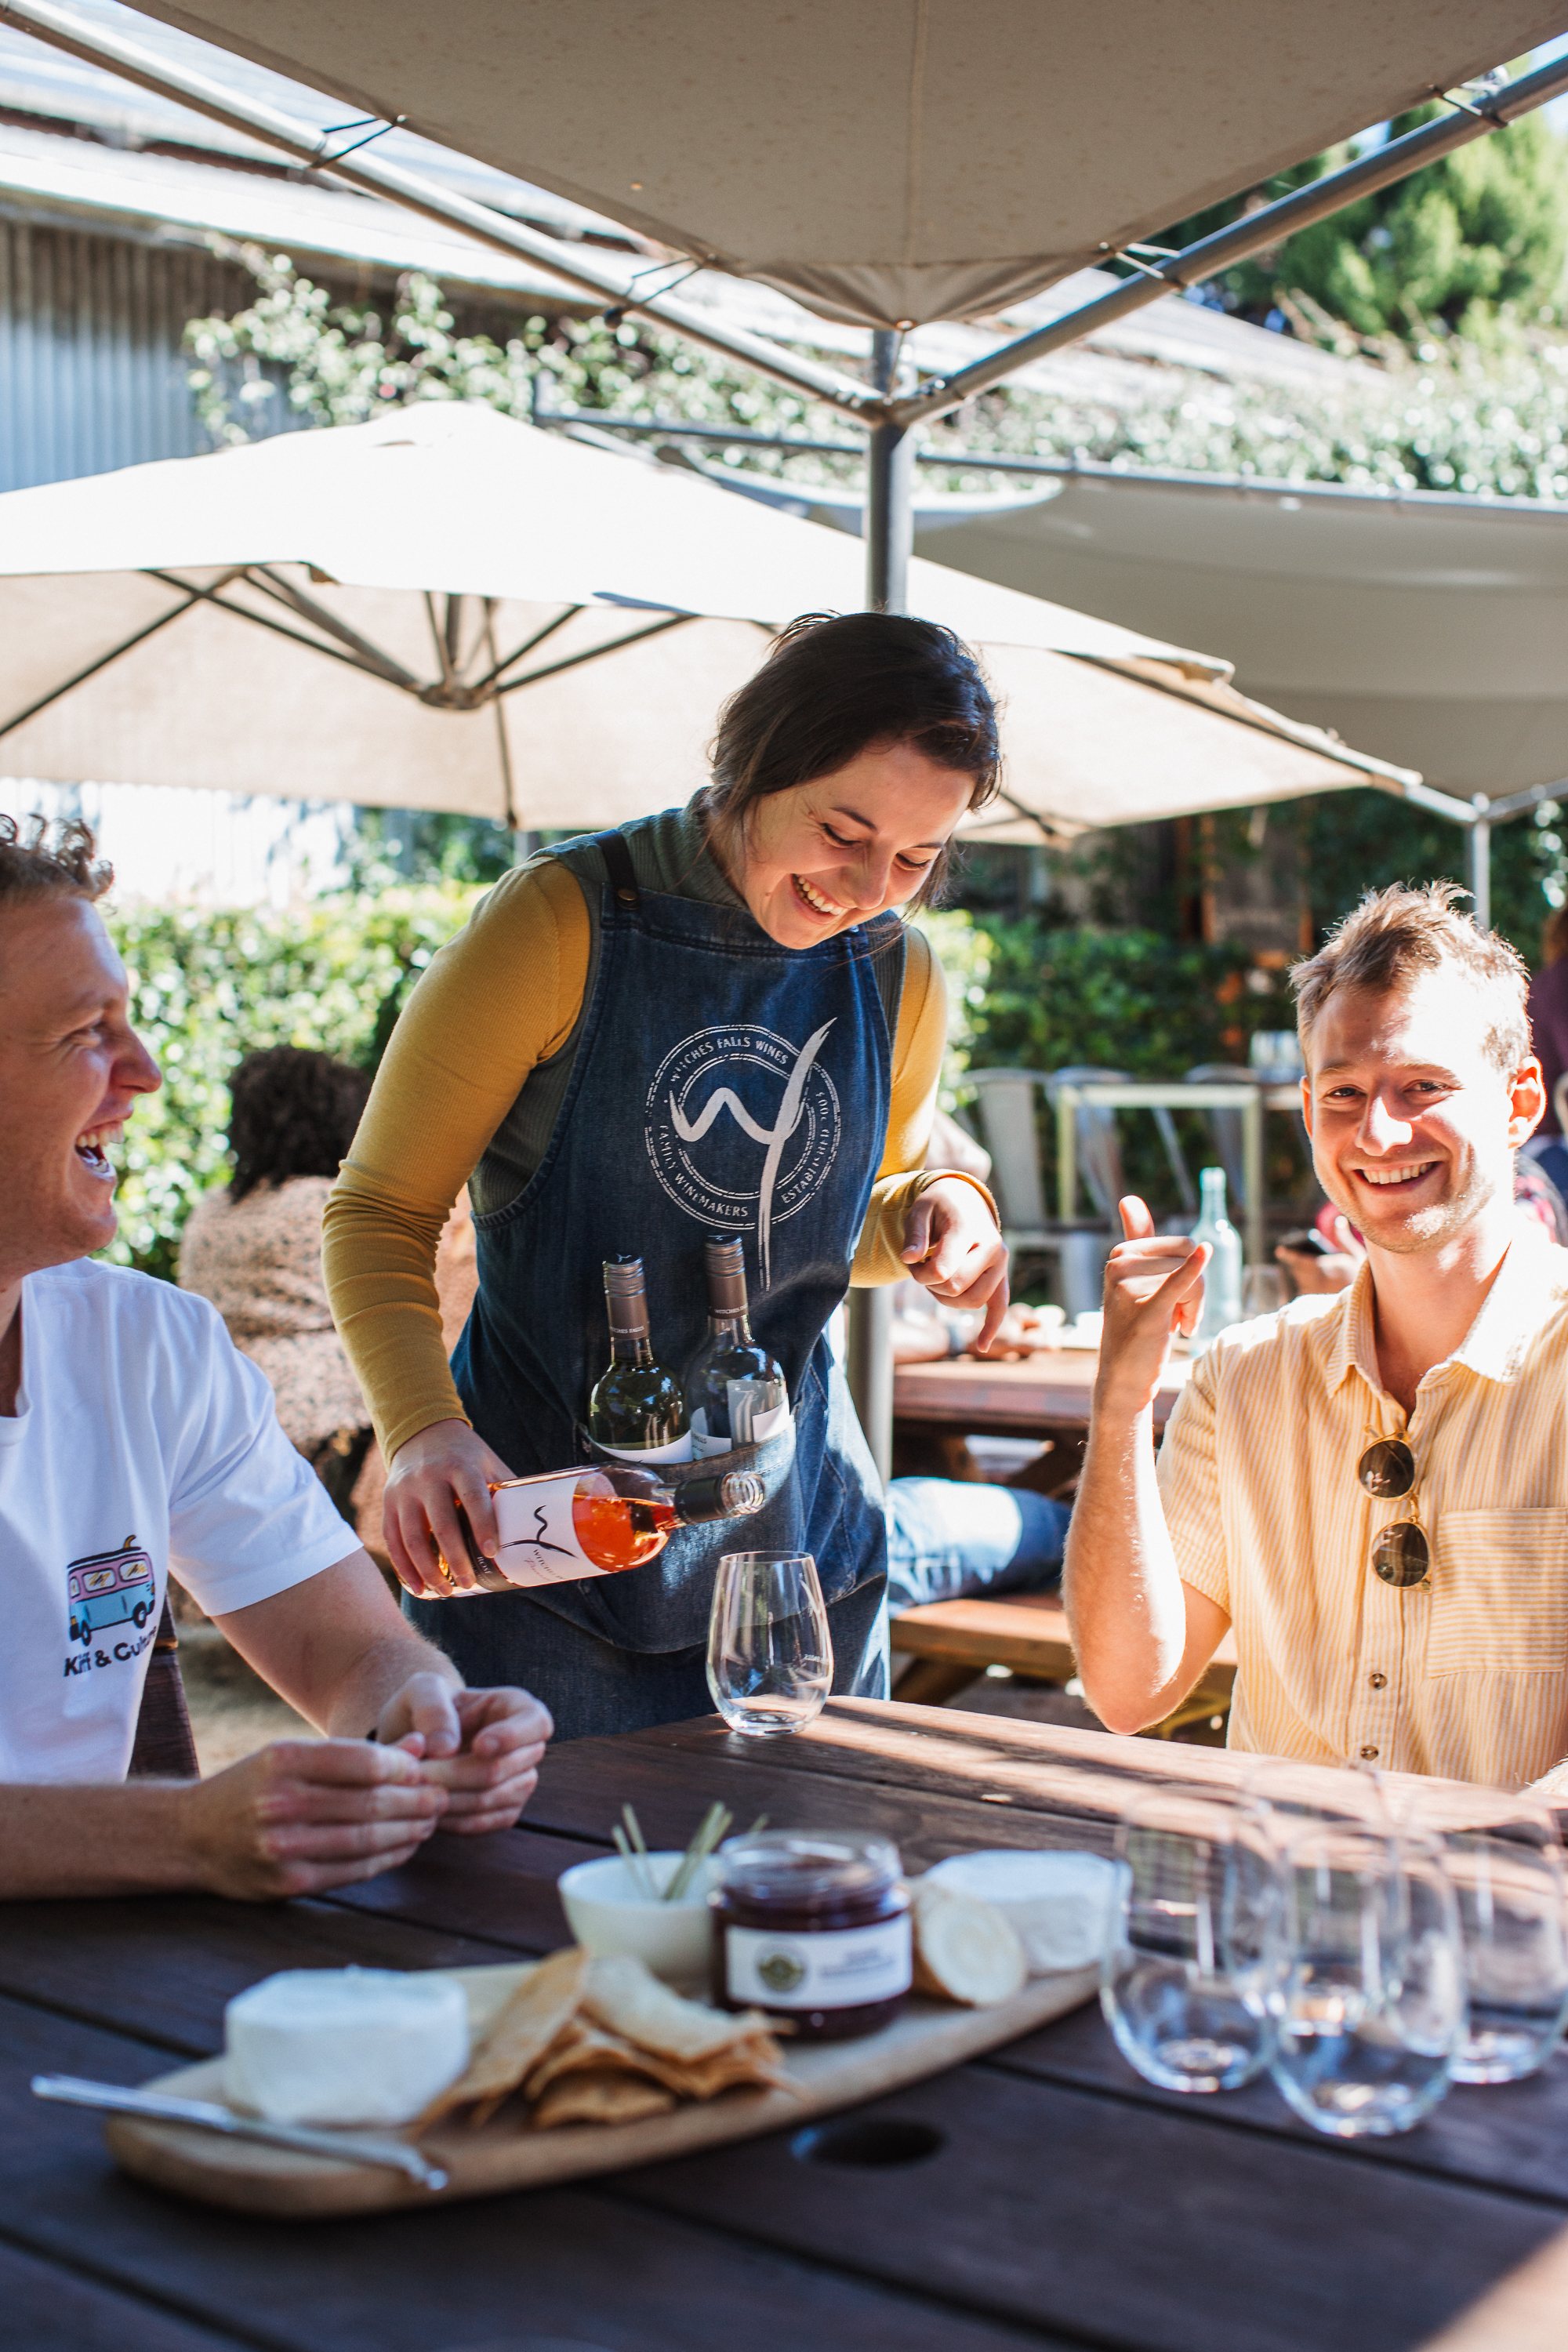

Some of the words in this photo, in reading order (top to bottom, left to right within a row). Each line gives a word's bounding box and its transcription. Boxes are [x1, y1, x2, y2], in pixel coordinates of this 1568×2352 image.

[670, 1041, 714, 1082] WITCHES
[717, 1036, 751, 1049] FALLS
[755, 1040, 789, 1065] WINES
[659, 1124, 679, 1170] FAMILY
[674, 1173, 749, 1217] WINEMAKERS
[95, 1649, 112, 1668] &
